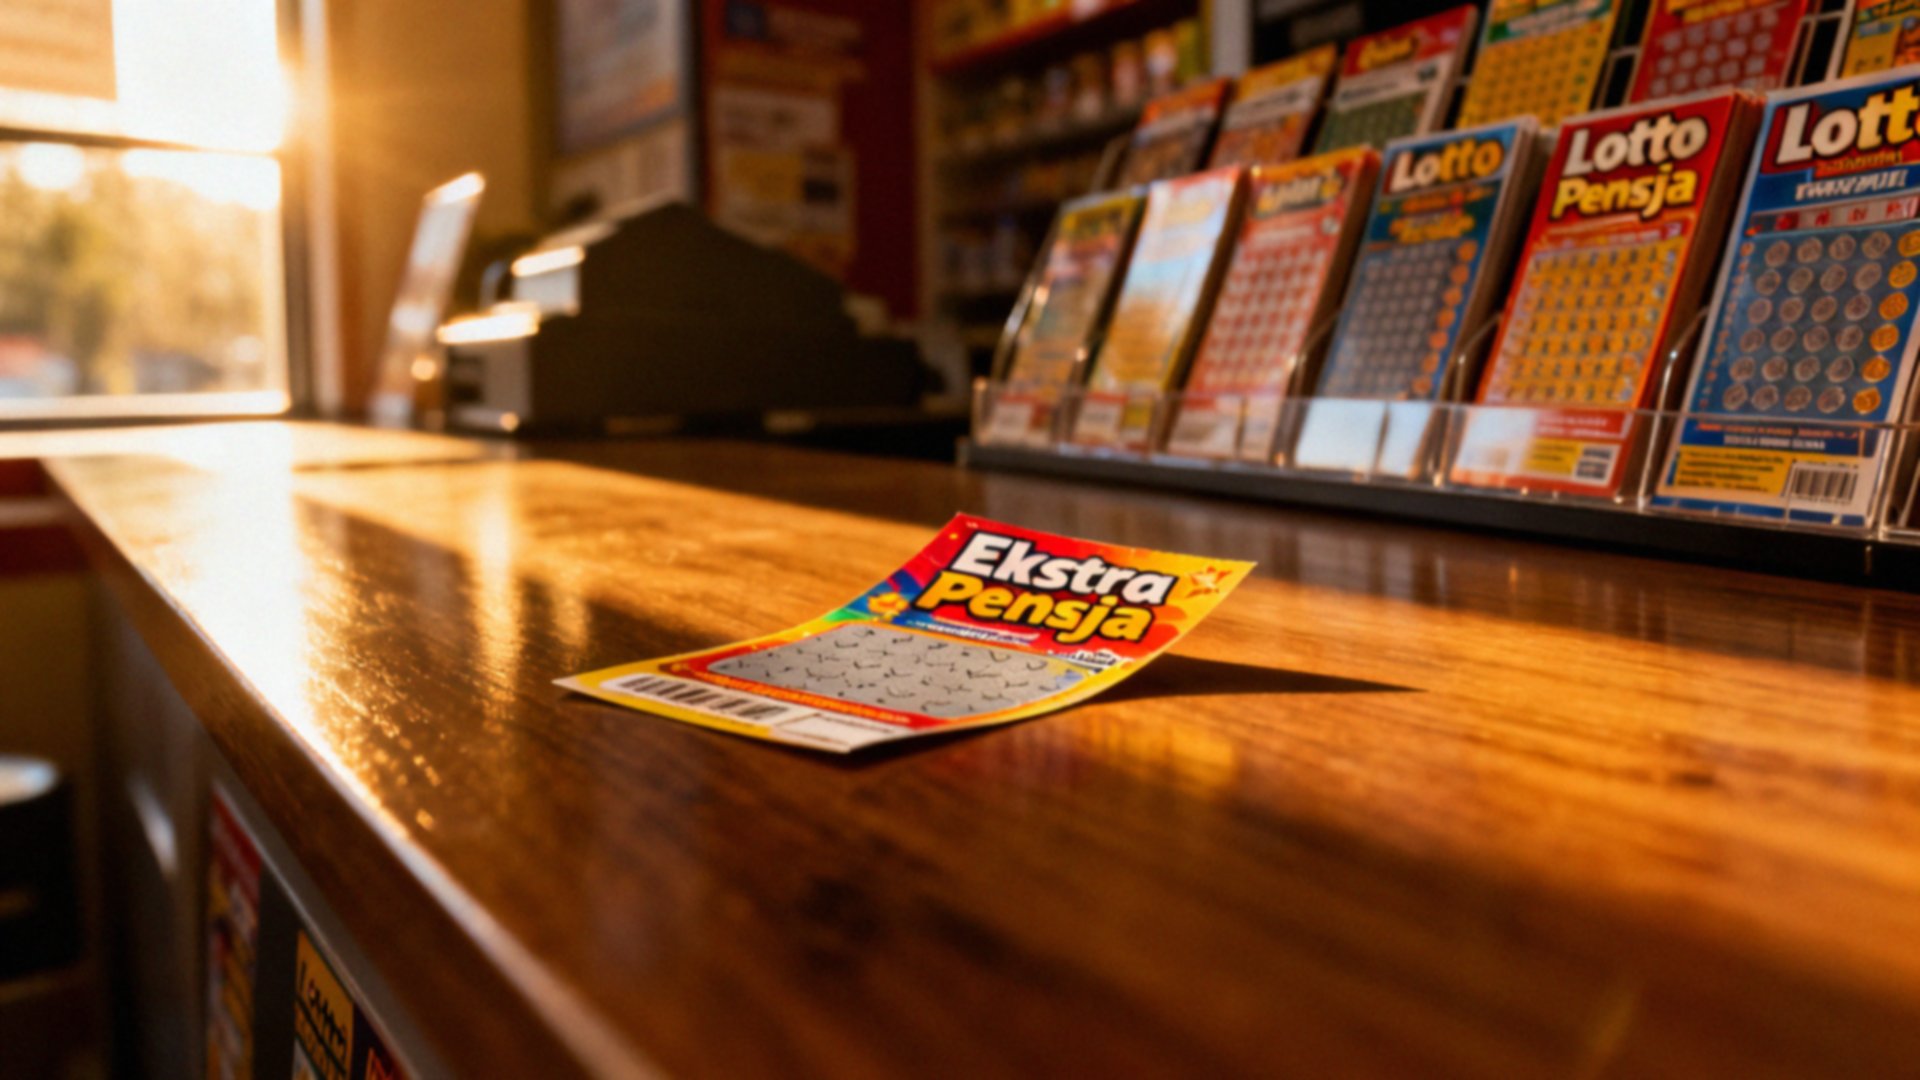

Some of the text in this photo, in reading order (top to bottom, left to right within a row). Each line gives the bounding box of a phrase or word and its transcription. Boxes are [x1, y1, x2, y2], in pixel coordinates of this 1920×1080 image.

[1562, 114, 1708, 176] Lotto
[1776, 85, 1920, 165] Lott
[1390, 139, 1502, 192] Lotto
[1551, 163, 1697, 219] Pensja
[951, 531, 1174, 604] Ekstra
[915, 571, 1153, 643] Pensja
